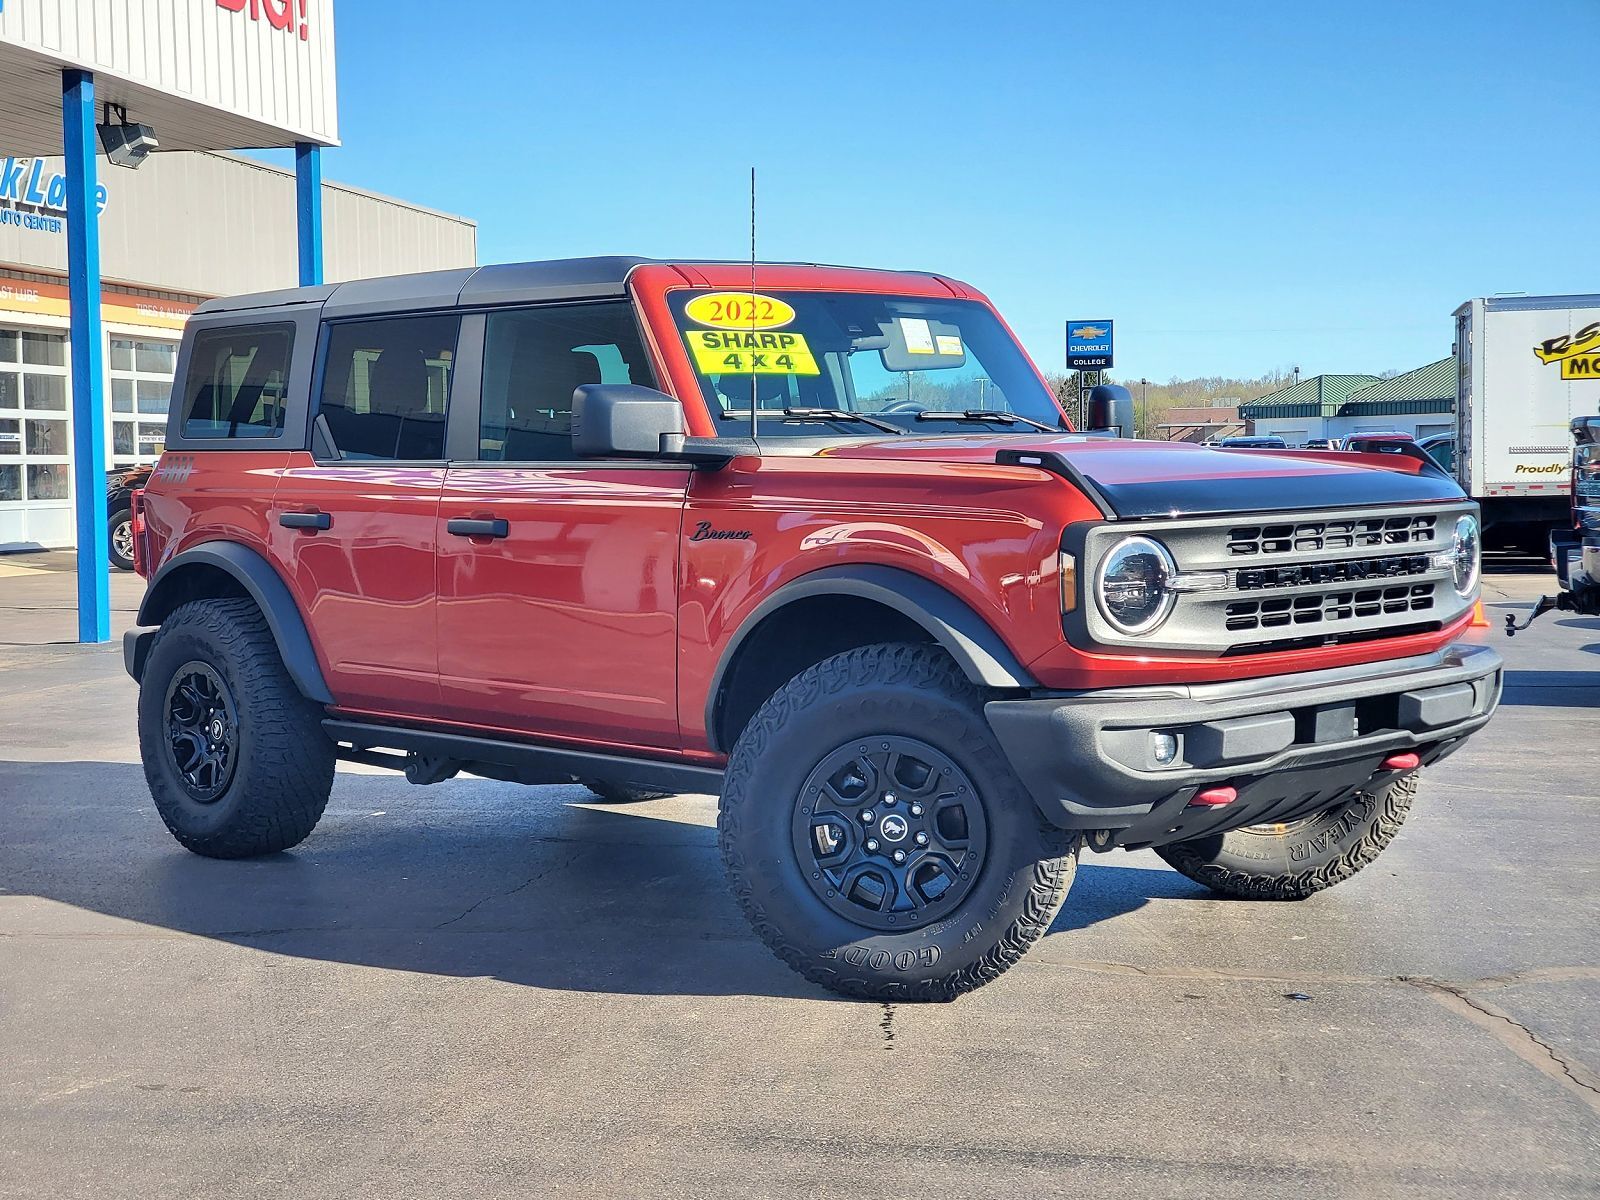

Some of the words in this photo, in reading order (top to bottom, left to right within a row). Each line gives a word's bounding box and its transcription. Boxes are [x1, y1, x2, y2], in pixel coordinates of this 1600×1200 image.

[26, 158, 107, 214] Lae
[0, 209, 21, 227] UTO
[23, 213, 62, 234] CENTER
[0, 285, 13, 300] ST
[15, 287, 40, 303] LUBE
[136, 303, 158, 319] TIRES
[709, 300, 775, 321] 2022
[701, 331, 796, 350] SHARP
[1070, 344, 1110, 352] CHEVROLET
[1073, 358, 1106, 366] COLLEGE
[1514, 463, 1566, 475] Proudly
[689, 520, 753, 541] Bronco
[1289, 808, 1362, 862] YEAR
[845, 943, 942, 971] GOOD
